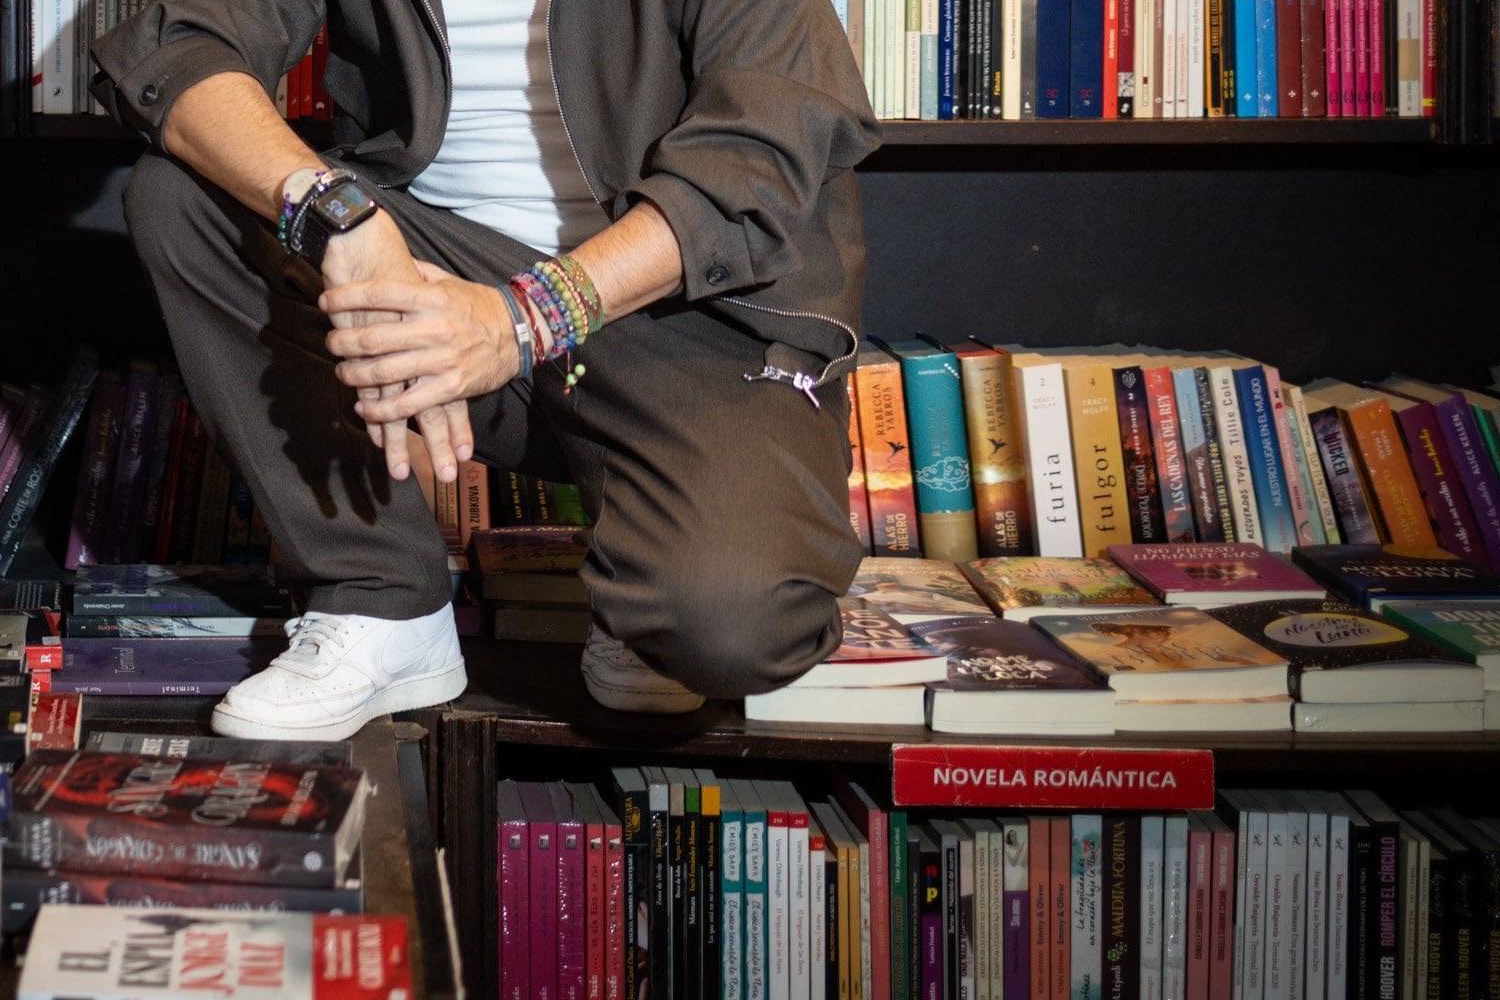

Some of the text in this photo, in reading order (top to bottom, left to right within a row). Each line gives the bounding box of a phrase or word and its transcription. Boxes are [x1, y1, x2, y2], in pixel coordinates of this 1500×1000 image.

[1039, 378, 1046, 387] 2
[1090, 377, 1096, 386] 4
[876, 383, 885, 436] REBECCA
[885, 387, 893, 432] YARROS
[988, 379, 997, 432] REBECCA
[997, 383, 1005, 428] YARROS
[1221, 378, 1239, 445] Tillie Cole
[1157, 394, 1186, 511] LAS CADENAS DEL REY
[1250, 378, 1282, 506] NUESTRO LUGAR EN EL MUNDO
[1322, 431, 1350, 475] WICKED
[1450, 415, 1480, 475] ALICE KELLEN
[469, 485, 480, 524] ZUBKOVA
[1047, 452, 1066, 525] furia
[1095, 443, 1117, 534] fulgor
[1234, 455, 1255, 539] RECUERDOS TUYOS
[886, 514, 897, 551] ALAS DE
[896, 513, 909, 551] HIERRO
[996, 511, 1006, 548] ALAS DE
[1005, 510, 1016, 548] HIERRO
[1177, 546, 1235, 554] PIENSO
[40, 653, 52, 664] R
[961, 654, 1030, 668] NO ME
[981, 670, 1049, 681] LOCA
[162, 685, 200, 693] Terminal
[933, 765, 1177, 789] NOVELA ROMÁNTICA
[624, 797, 632, 842] ALFAGUARA
[875, 818, 883, 848] robadas
[728, 827, 737, 876] EMILY BARR
[751, 827, 759, 876] EMILY BARR
[1036, 883, 1044, 908] Oliver
[1075, 859, 1086, 929] La fragilidad de
[1087, 841, 1101, 945] un corazón bajo la lluvia
[1112, 821, 1126, 937] MALDITA FORTUNA
[1313, 872, 1321, 889] Isaac
[1378, 837, 1395, 946] ROMPER EL CÍRCULO
[1011, 899, 1021, 926] Sin amor
[1313, 891, 1321, 907] Rosa
[1313, 910, 1321, 920] Las
[1037, 921, 1045, 944] Emmy
[1057, 921, 1066, 944] Emmy
[1271, 874, 1281, 989] Osvaldo Baigorria Terminal 2020
[1312, 948, 1320, 972] noches
[1380, 957, 1395, 1000] HOOVER
